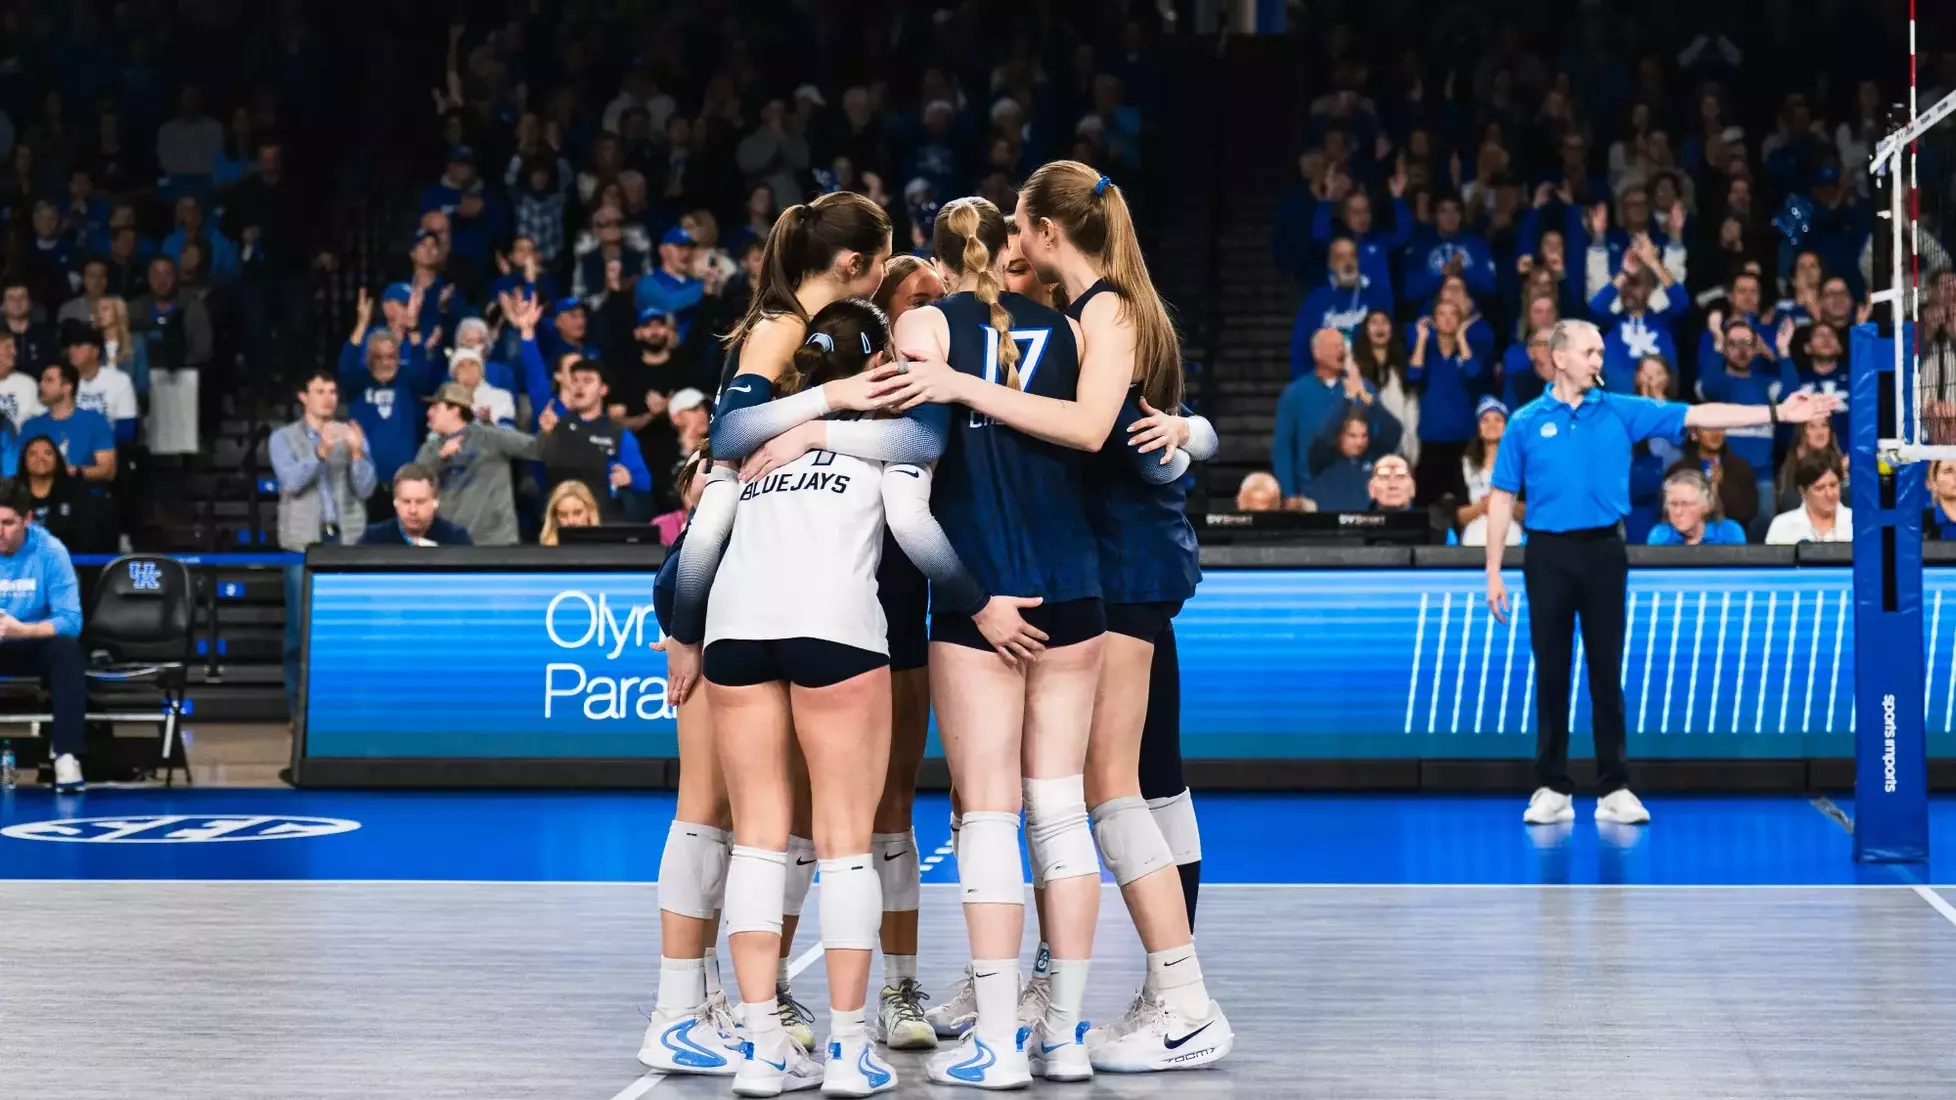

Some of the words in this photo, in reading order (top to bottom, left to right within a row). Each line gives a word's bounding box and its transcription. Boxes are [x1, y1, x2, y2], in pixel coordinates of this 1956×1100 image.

[978, 324, 1052, 393] 17
[739, 472, 850, 501] BLUEJAYS
[129, 561, 163, 590] UK
[544, 663, 677, 719] Para
[1881, 694, 1897, 738] sports
[1882, 738, 1897, 792] imports
